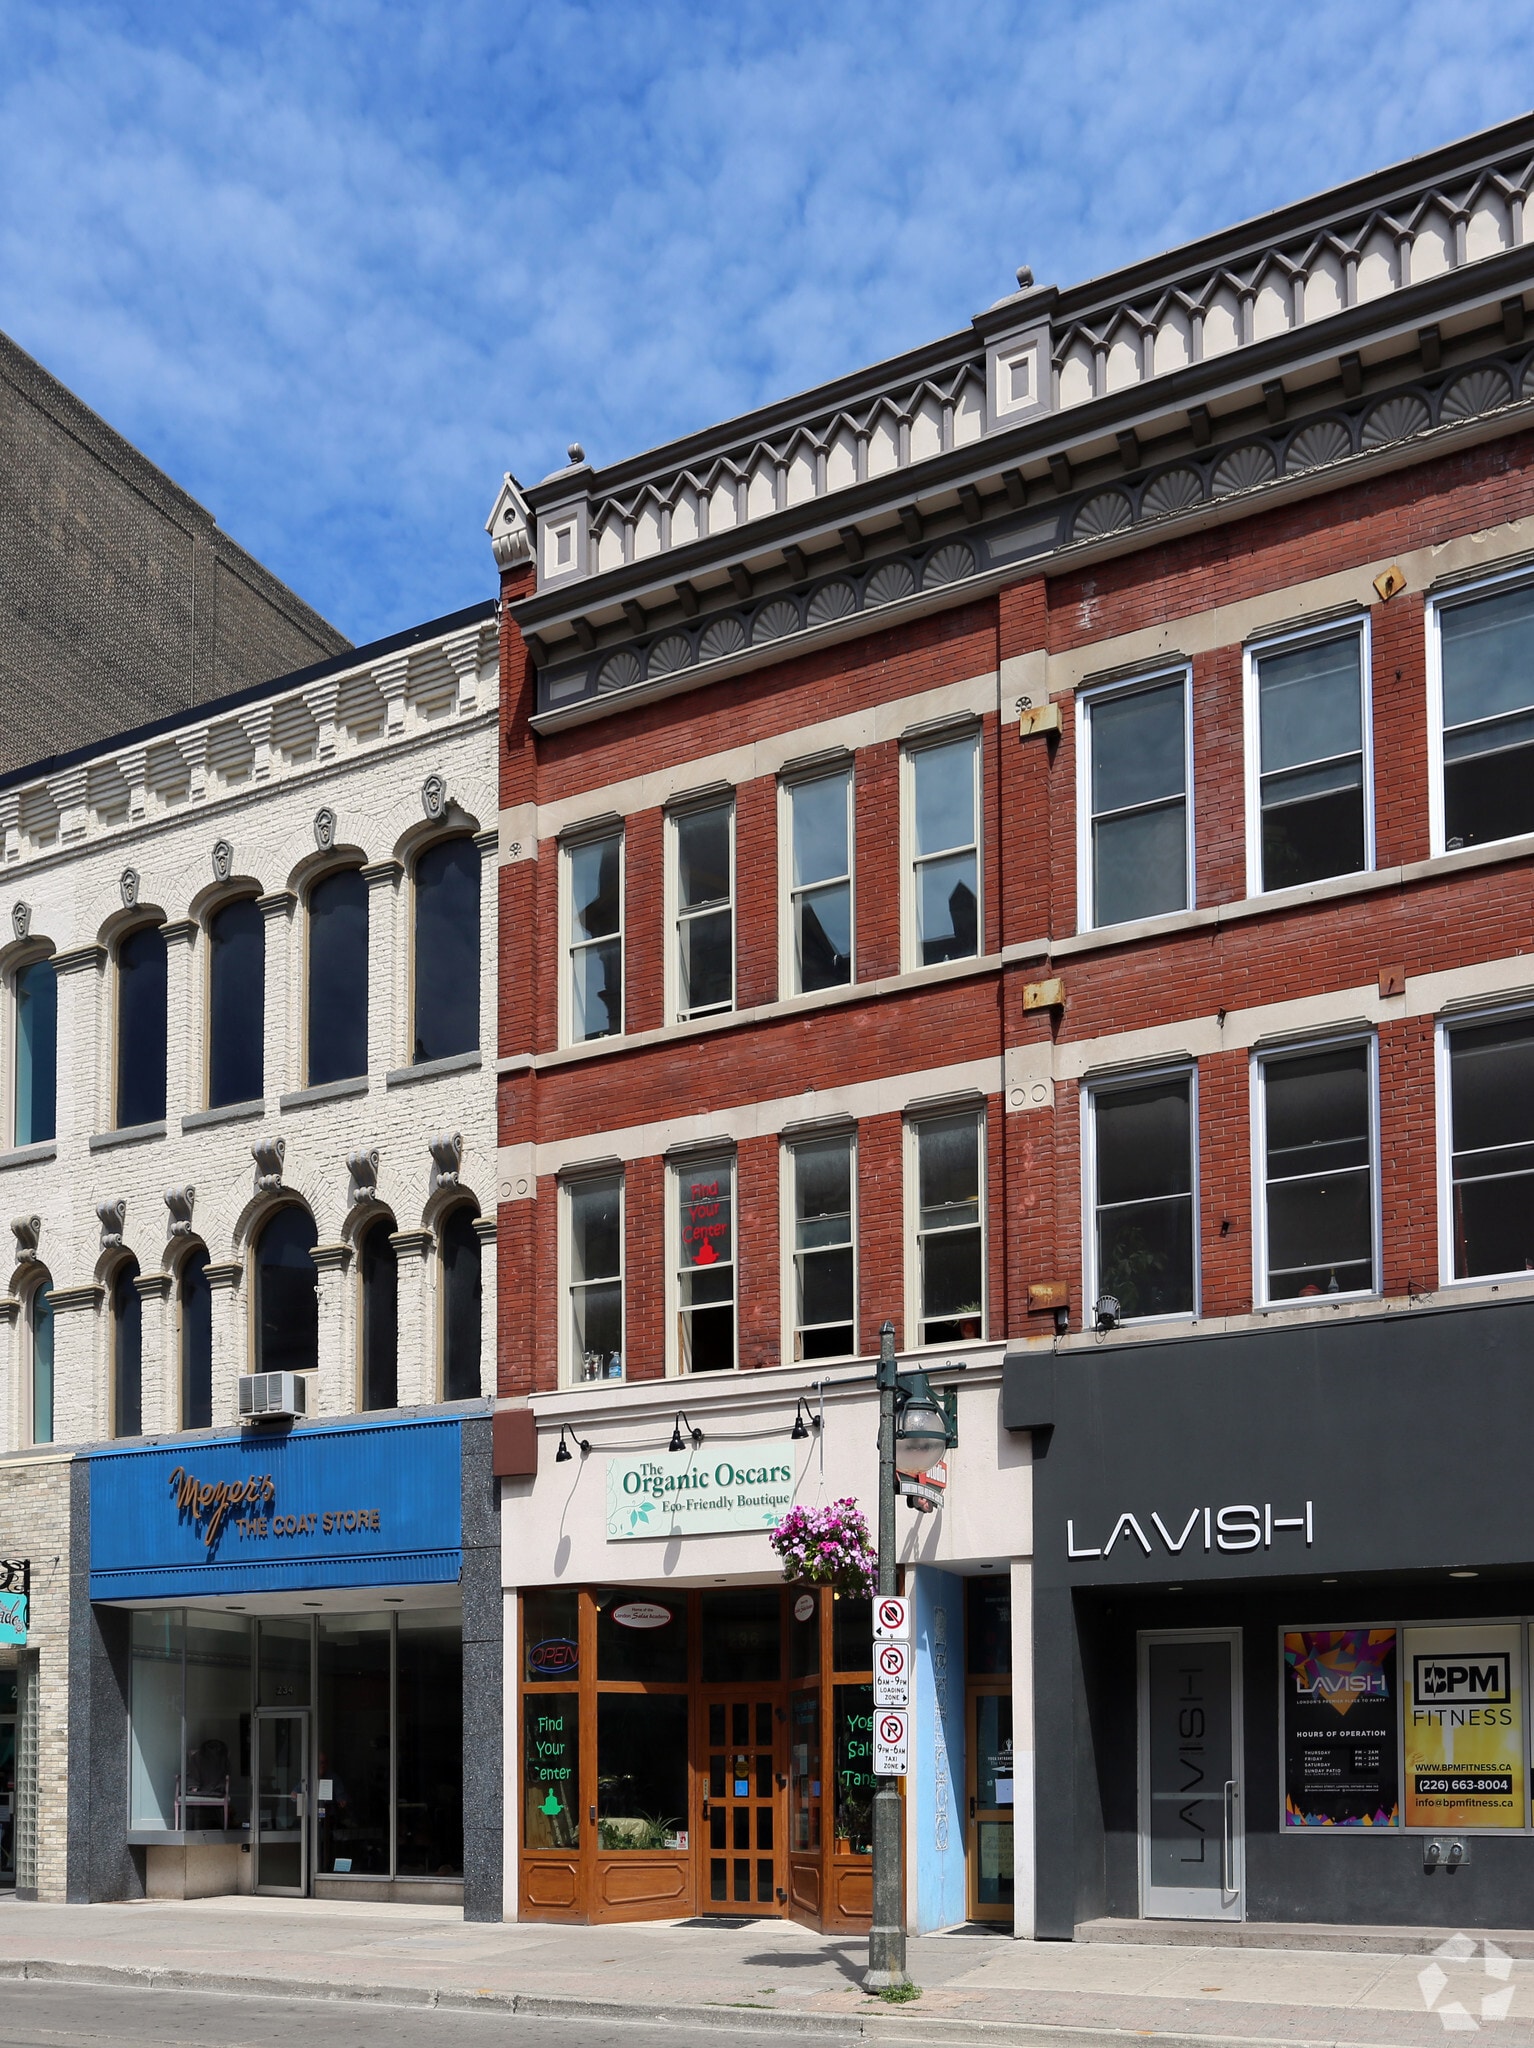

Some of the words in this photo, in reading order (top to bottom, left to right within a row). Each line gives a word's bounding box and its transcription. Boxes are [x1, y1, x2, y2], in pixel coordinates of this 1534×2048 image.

[690, 1180, 719, 1201] Find
[688, 1203, 720, 1223] Your
[682, 1223, 727, 1244] Center
[640, 1462, 664, 1476] The
[623, 1467, 709, 1498] Organic
[714, 1462, 791, 1487] Oscars
[168, 1466, 275, 1546] Meyer's
[662, 1496, 734, 1513] Eco-Friendly
[737, 1493, 790, 1508] Boutique
[236, 1517, 268, 1537] THE
[272, 1513, 318, 1535] COAT
[322, 1508, 381, 1531] STORE
[1067, 1500, 1313, 1557] LAVISH
[531, 1645, 579, 1665] OPEN
[1296, 1674, 1386, 1693] LAVISH
[1424, 1664, 1499, 1694] BPM
[537, 1716, 564, 1733] Find
[847, 1714, 873, 1732] Yog
[1413, 1708, 1512, 1726] FITNESS
[536, 1741, 566, 1758] Your
[1178, 1668, 1206, 1862] LAVISH
[1415, 1763, 1512, 1771] WWW.BPMFITNESS.CA
[841, 1770, 877, 1788] Tang
[1419, 1779, 1449, 1792] (226)
[1451, 1779, 1508, 1790] 663-8004
[1415, 1798, 1513, 1809] info@bpmfitness.ca
